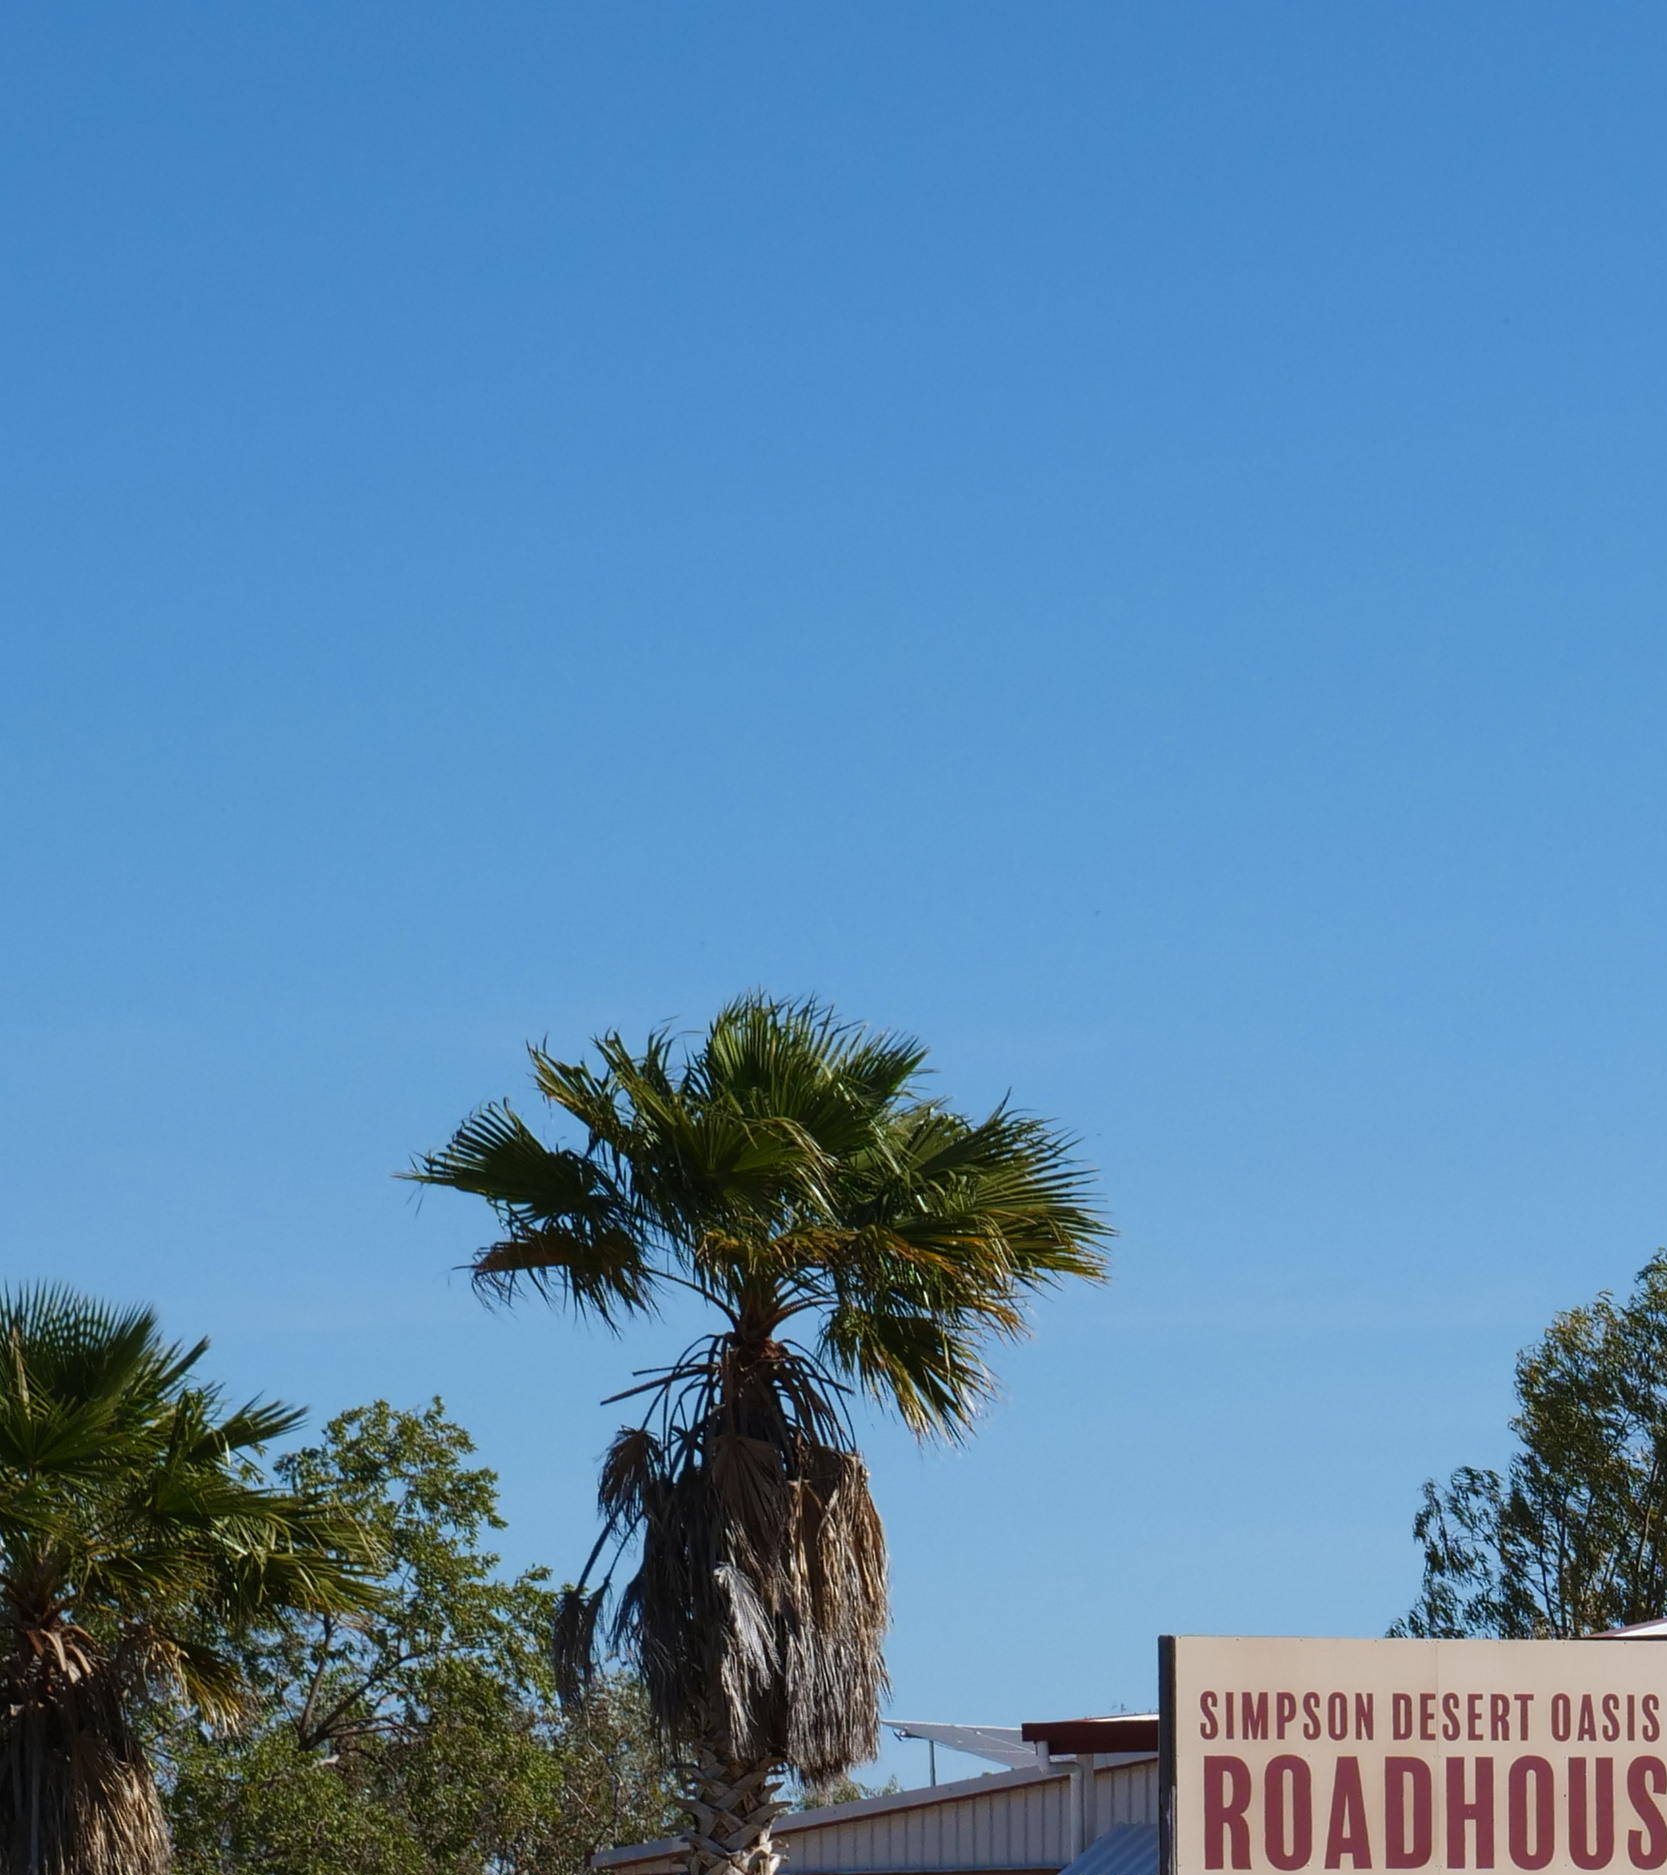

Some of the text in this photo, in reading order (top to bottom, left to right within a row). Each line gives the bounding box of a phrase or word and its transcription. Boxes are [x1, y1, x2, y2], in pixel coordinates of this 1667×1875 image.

[1199, 1691, 1661, 1743] SIMPSON DESERT OASIS
